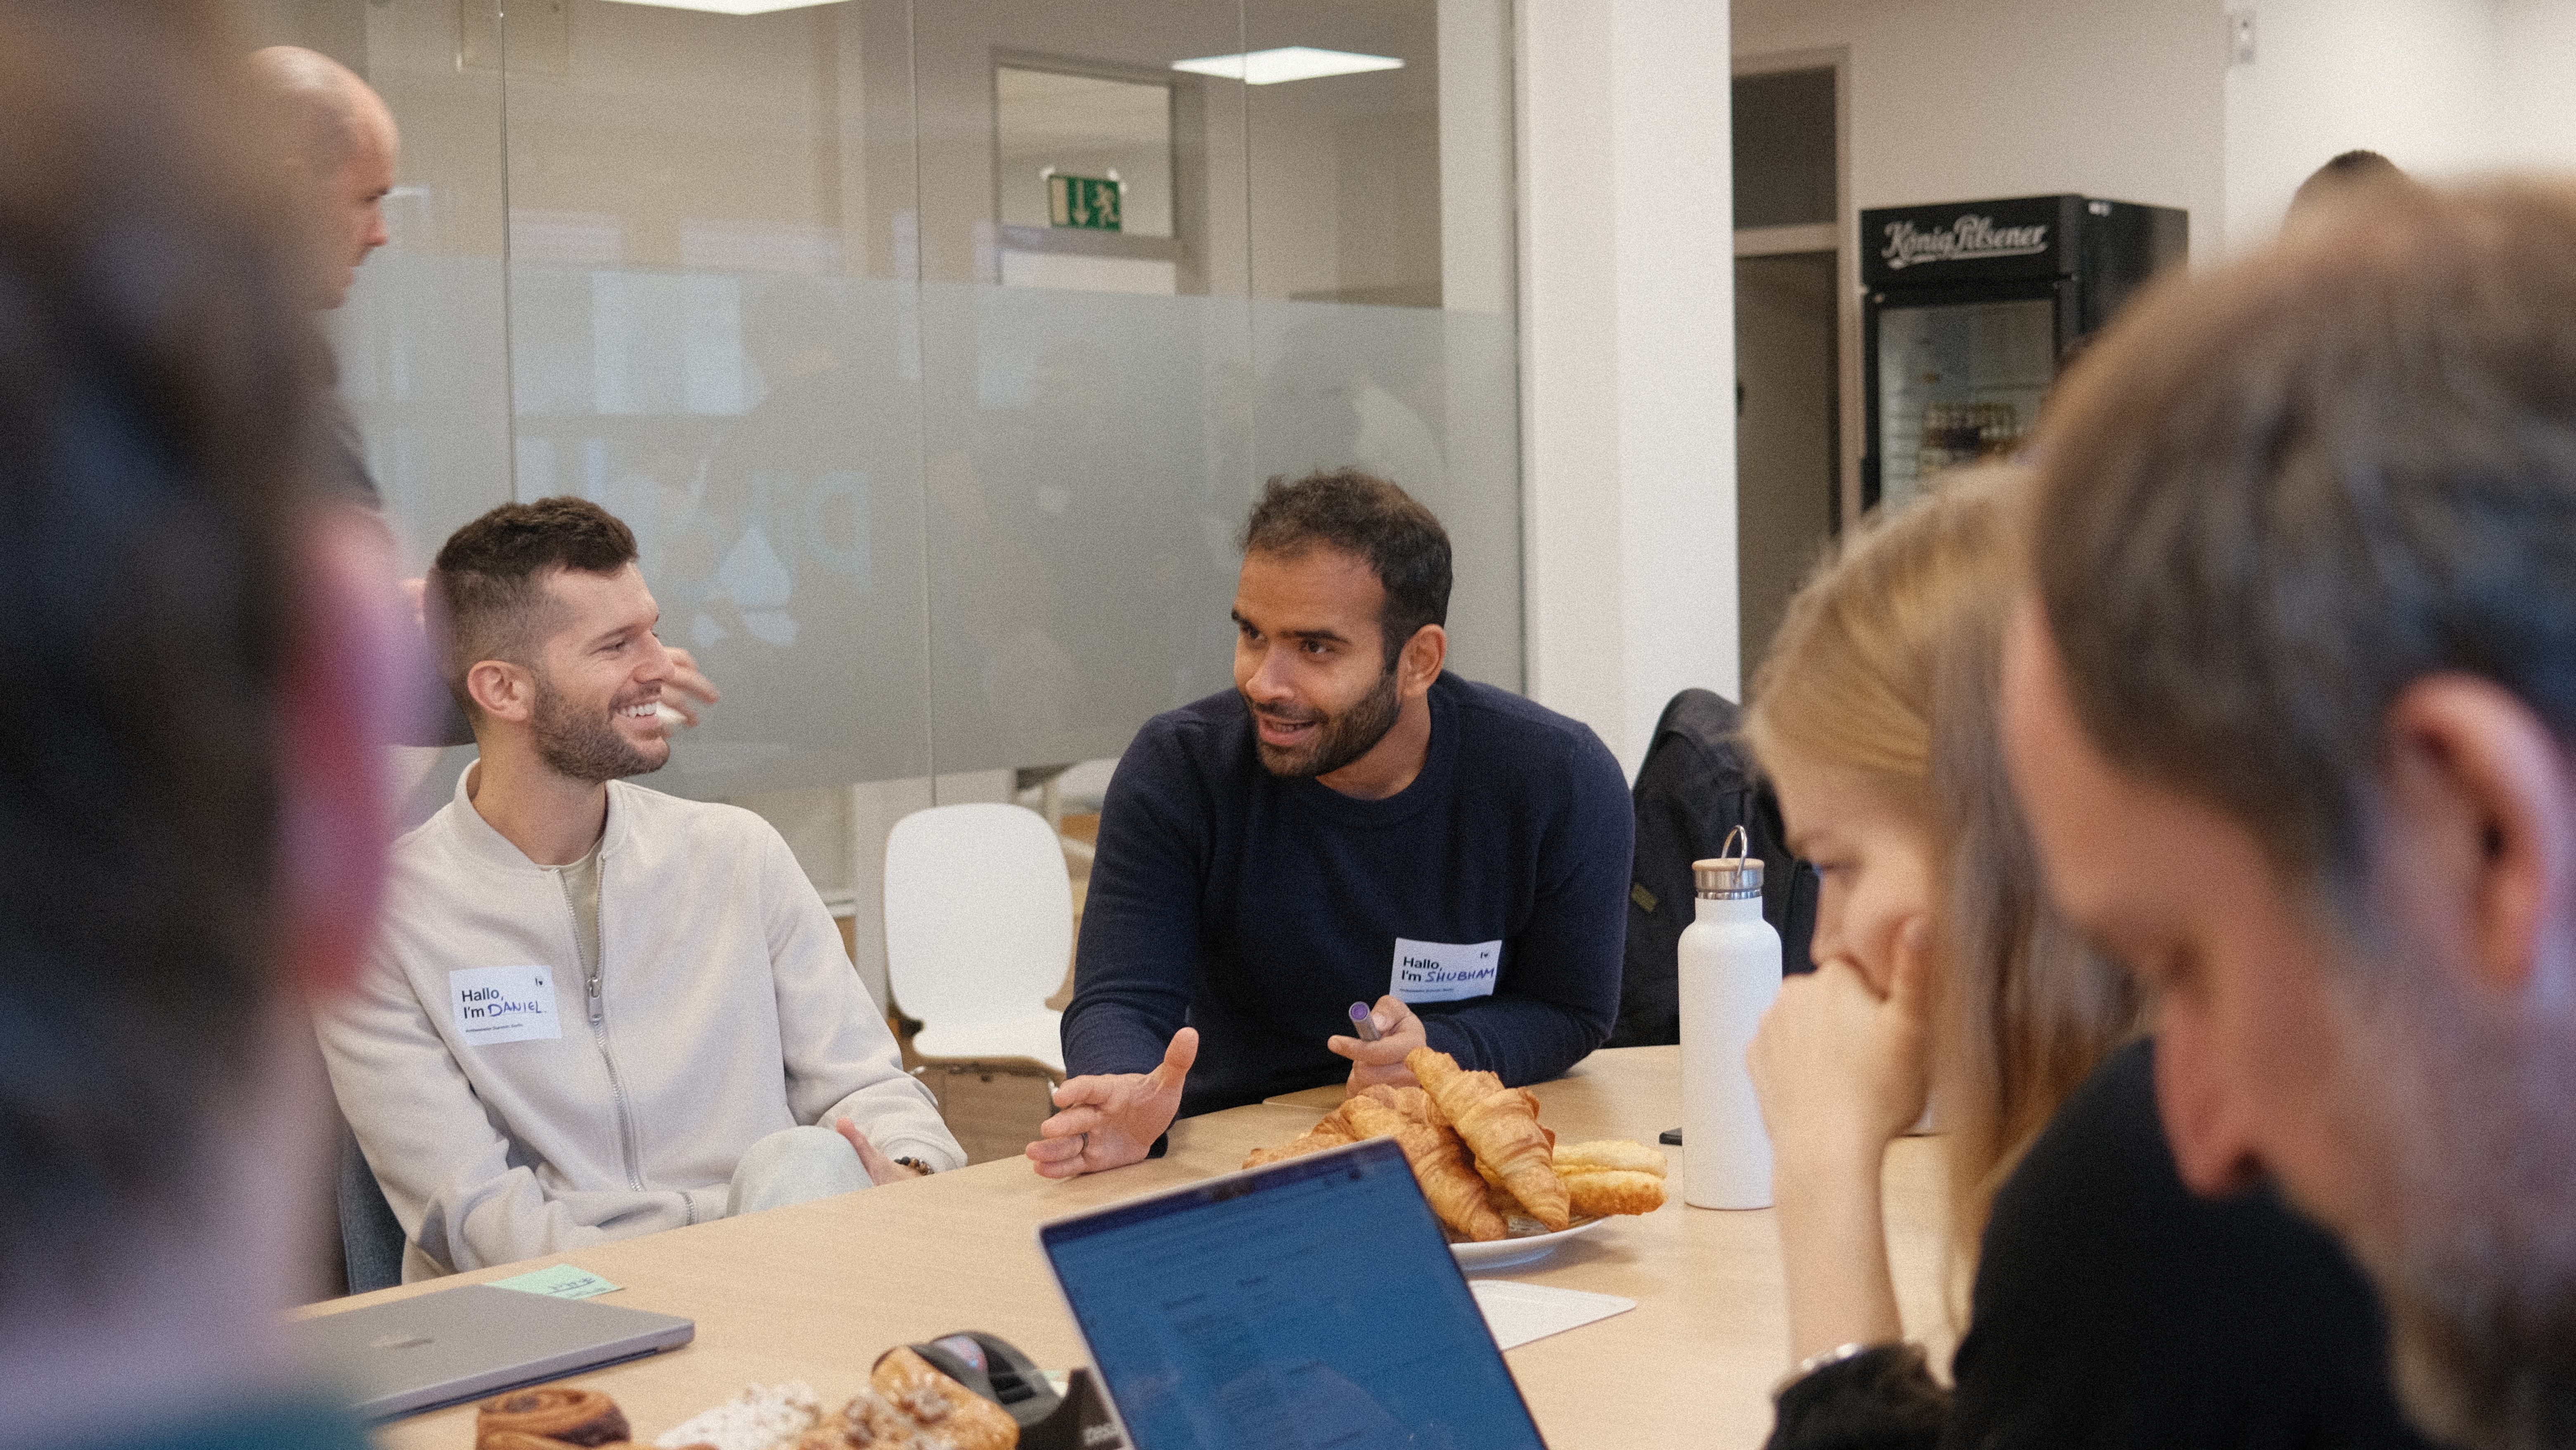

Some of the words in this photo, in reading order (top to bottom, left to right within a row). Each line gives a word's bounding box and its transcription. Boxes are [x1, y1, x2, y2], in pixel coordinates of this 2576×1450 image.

[1953, 213, 2048, 253] Pilsener
[1404, 957, 1442, 971] Hallo,
[1402, 970, 1421, 982] I'm
[1426, 968, 1495, 982] SHUBHAM
[462, 988, 504, 1002] Hallo,
[464, 1007, 485, 1019] I'm
[487, 1001, 542, 1017] DANIEL
